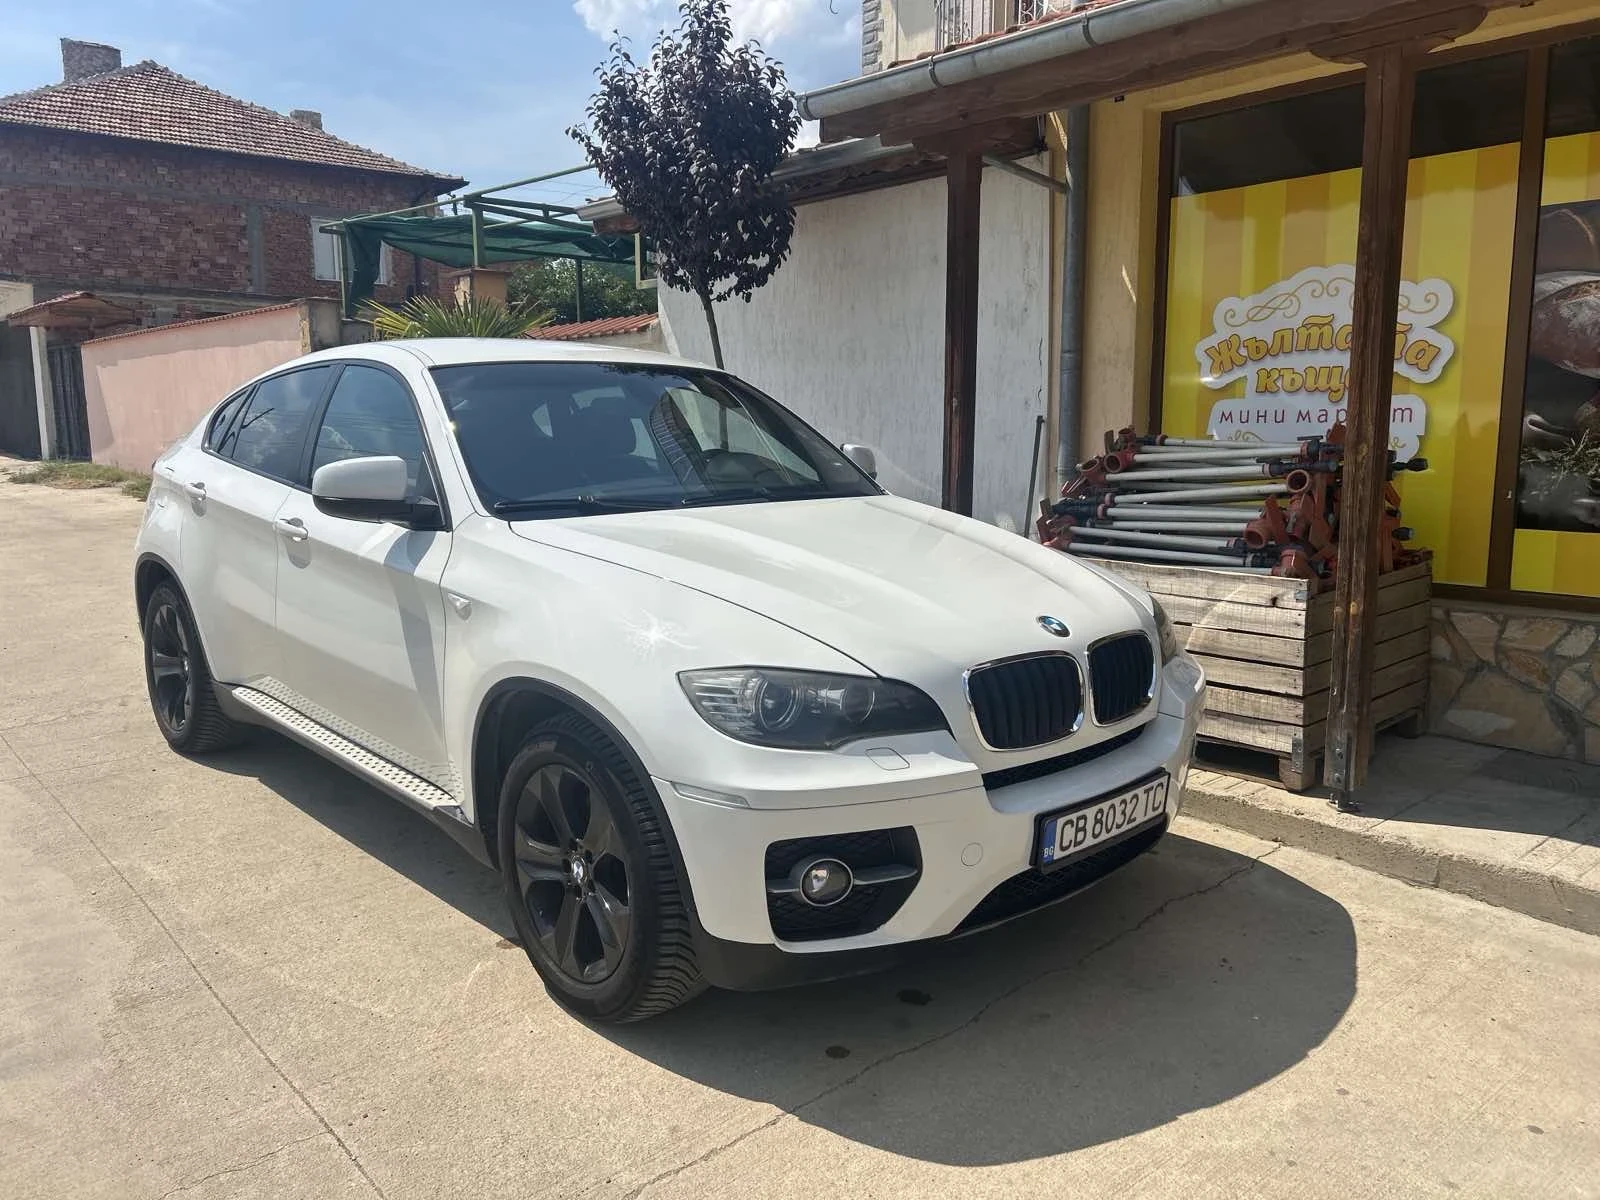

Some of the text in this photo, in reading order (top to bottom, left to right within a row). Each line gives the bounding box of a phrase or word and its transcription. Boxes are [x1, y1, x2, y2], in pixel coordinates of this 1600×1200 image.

[1256, 366, 1351, 403] къщ
[1219, 407, 1413, 426] мини март
[1059, 782, 1164, 852] CB 8032 TC
